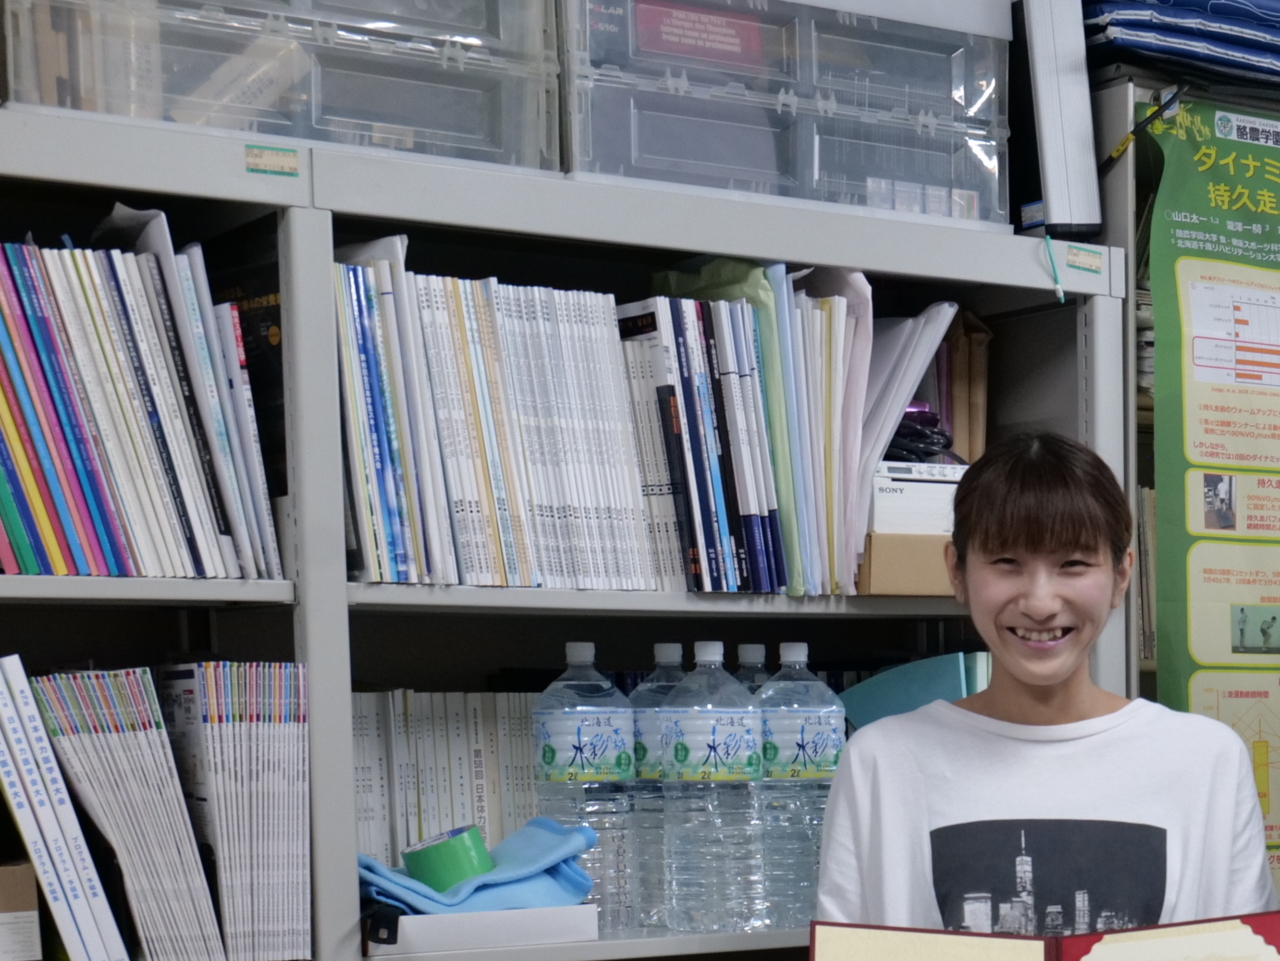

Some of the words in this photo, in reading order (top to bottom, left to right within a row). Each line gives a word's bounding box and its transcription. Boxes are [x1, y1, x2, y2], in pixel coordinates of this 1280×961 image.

[580, 716, 613, 728] 北海道
[716, 717, 746, 727] 北海道
[804, 716, 833, 726] 北海道
[7, 716, 46, 808] 日本体力医学会大会
[28, 714, 66, 807] 日本体力医学会大会
[473, 749, 484, 780] 第58回
